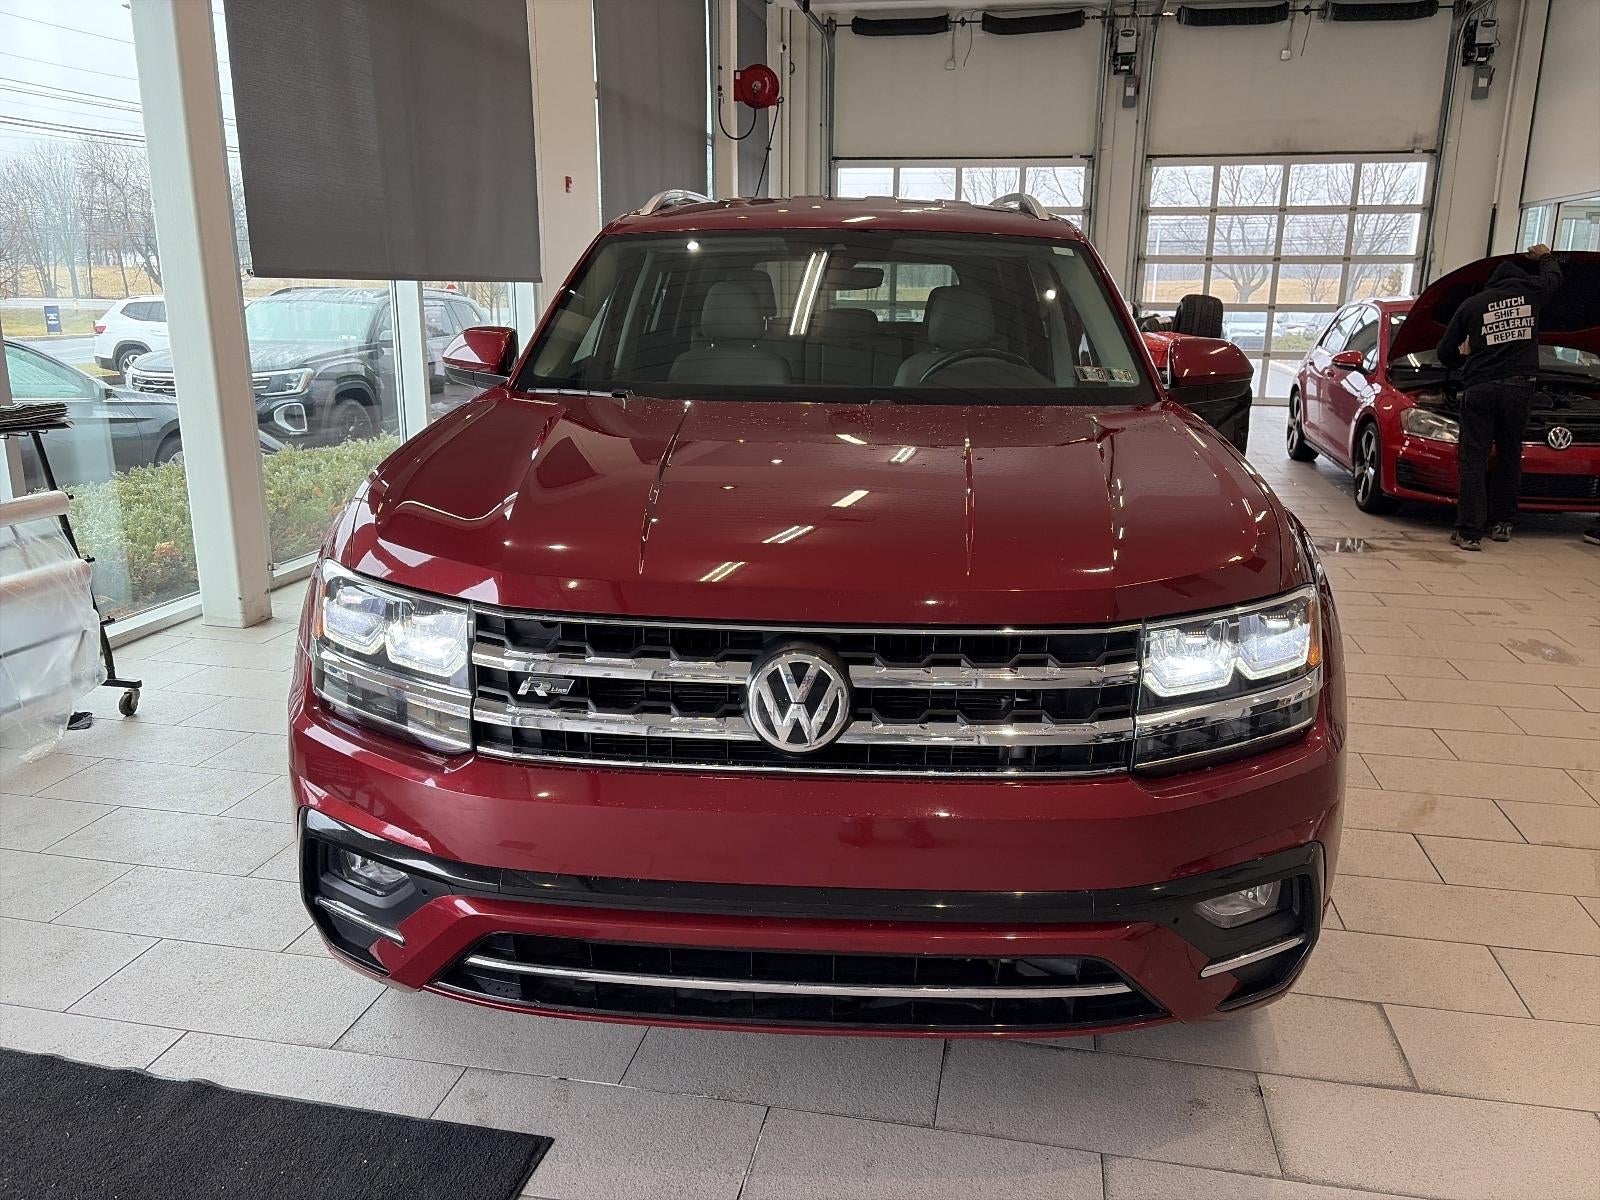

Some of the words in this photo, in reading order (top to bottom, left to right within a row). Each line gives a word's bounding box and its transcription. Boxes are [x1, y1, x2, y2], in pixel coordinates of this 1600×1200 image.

[1488, 295, 1525, 311] CLUTCH
[1494, 308, 1520, 320] SHIFT
[1481, 317, 1535, 335] ACCELERATE
[1493, 329, 1527, 342] REPEAT
[1548, 427, 1572, 449] VW
[517, 680, 551, 696] R
[748, 653, 849, 753] VW
